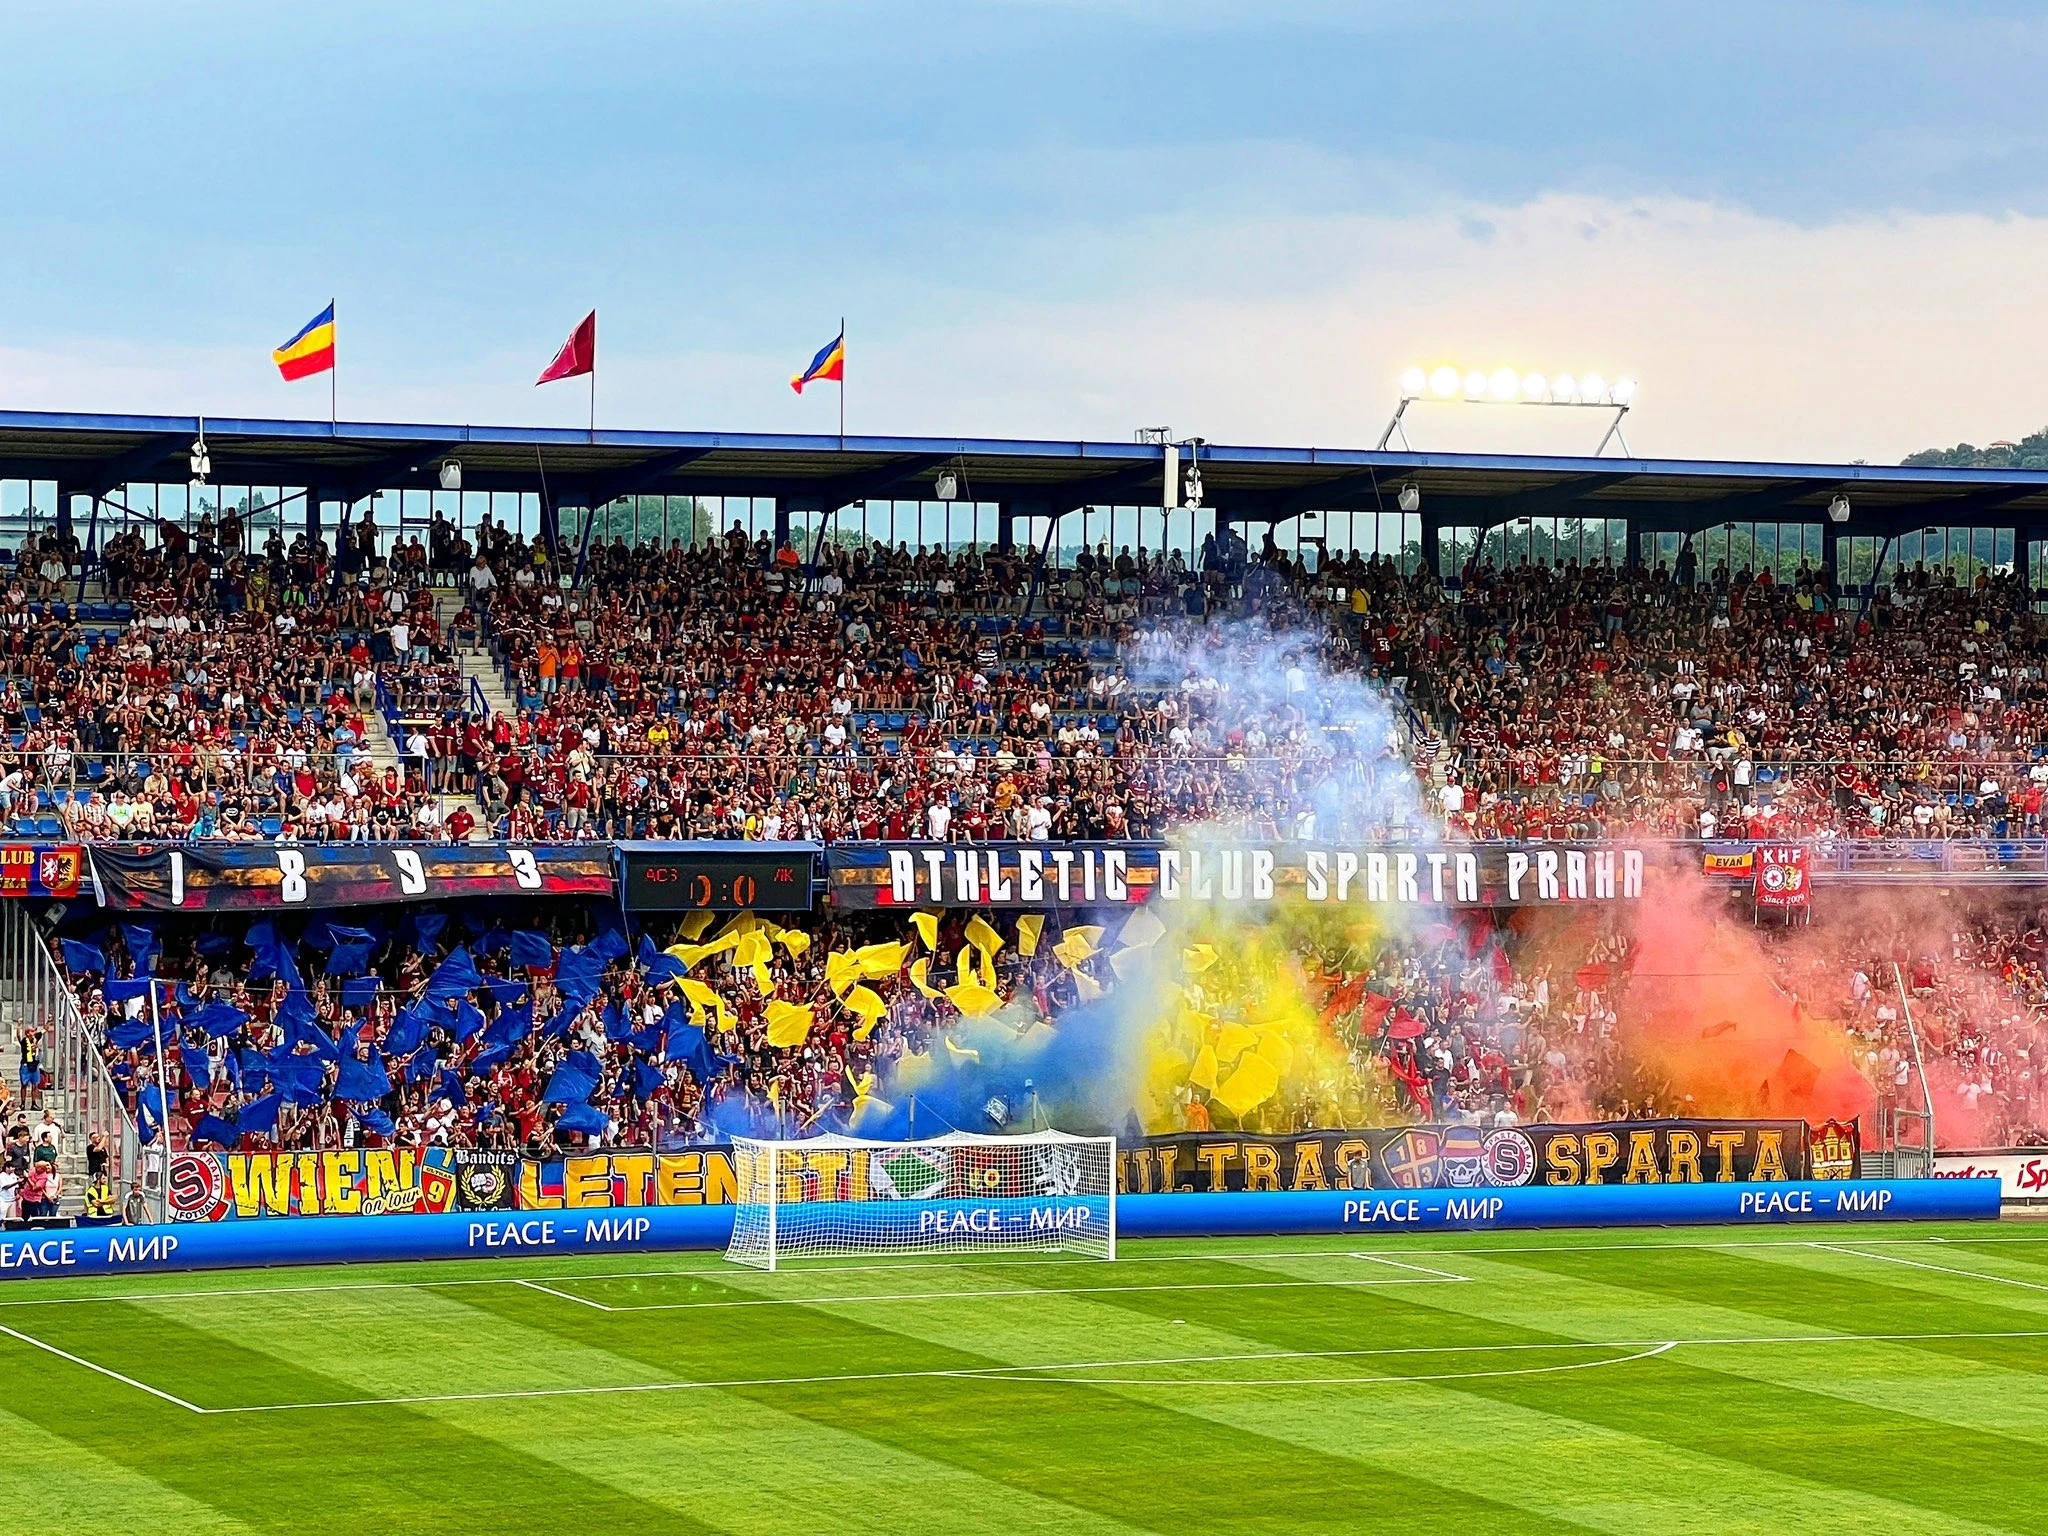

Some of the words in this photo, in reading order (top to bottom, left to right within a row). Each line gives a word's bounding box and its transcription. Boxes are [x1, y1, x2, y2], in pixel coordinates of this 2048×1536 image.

[1379, 640, 1391, 652] 56
[1763, 849, 1802, 864] KHF
[888, 850, 1127, 902] ATHLETIC
[1158, 850, 1276, 902] CLUB
[1305, 851, 1479, 903] SPARTA
[1506, 850, 1644, 901] PRAHA
[455, 1148, 515, 1165] Bandits
[1545, 1127, 1789, 1186] SPARTA
[229, 1150, 416, 1218] WIEN
[427, 1180, 446, 1204] 9
[179, 1200, 217, 1220] FOTBAL
[363, 1200, 385, 1215] on
[387, 1187, 421, 1211] tour
[1344, 1199, 1420, 1223] PEACE
[1740, 1190, 1814, 1214] PEACE
[920, 1209, 1001, 1233] PEACE
[469, 1220, 556, 1247] PEACE
